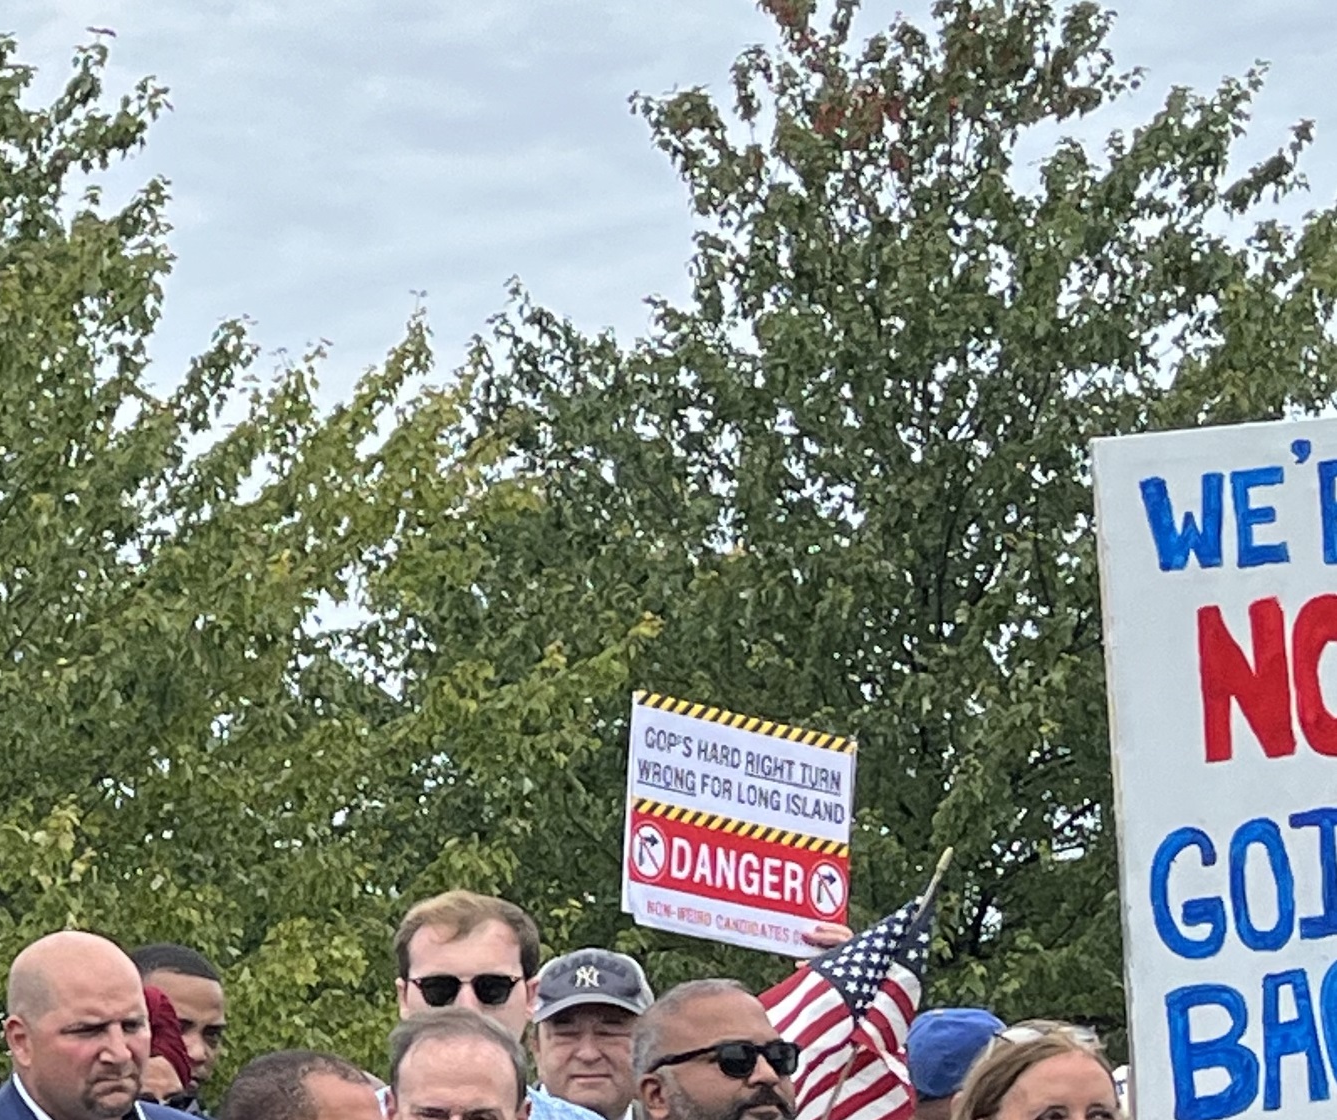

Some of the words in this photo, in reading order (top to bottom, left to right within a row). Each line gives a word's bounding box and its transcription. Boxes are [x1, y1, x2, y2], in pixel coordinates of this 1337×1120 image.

[637, 758, 696, 793] WRONG
[701, 774, 732, 801] FOR
[737, 781, 781, 812] LONG
[785, 793, 845, 824] ISLAND
[644, 726, 693, 758] GOP'S
[697, 740, 741, 769] HARD
[745, 751, 794, 781] RIGHT
[800, 762, 841, 792] TURN
[670, 837, 804, 905] DANGER
